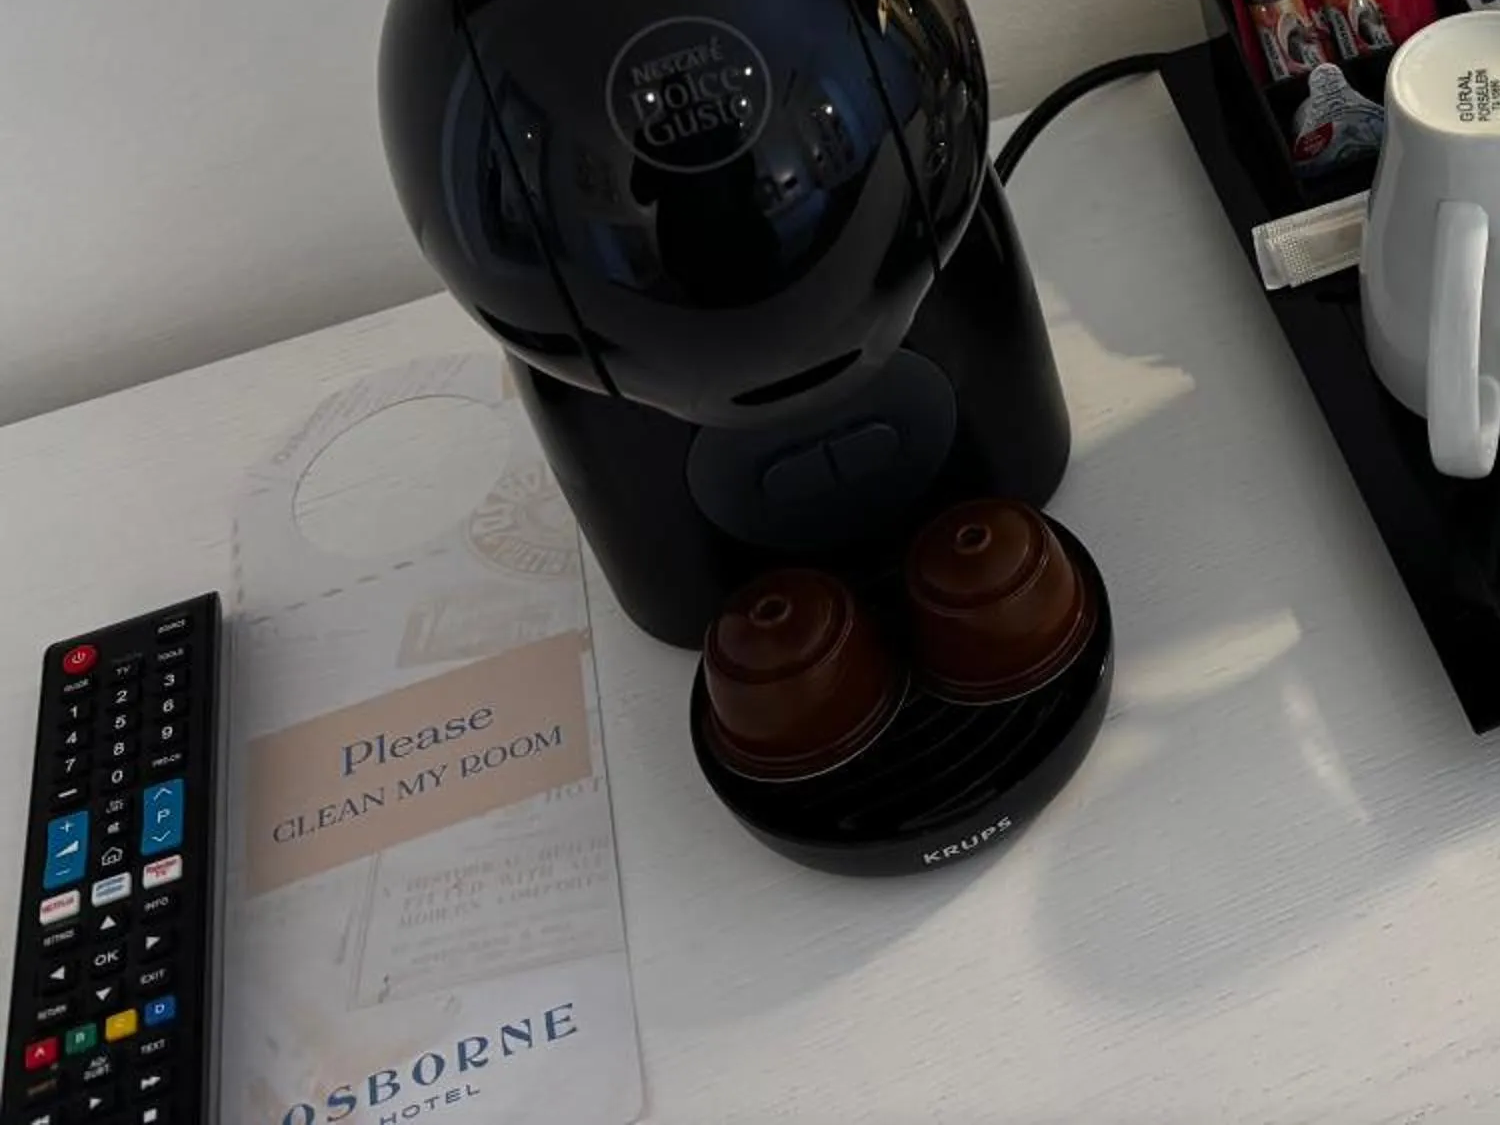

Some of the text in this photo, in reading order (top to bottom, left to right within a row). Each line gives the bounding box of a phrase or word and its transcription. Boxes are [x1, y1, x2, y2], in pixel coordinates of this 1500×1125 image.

[164, 672, 176, 687] 3
[115, 689, 129, 704] 2
[69, 704, 78, 719] 1
[162, 698, 175, 713] 6
[114, 714, 127, 730] 5
[65, 730, 78, 744] 4
[161, 725, 174, 740] 9
[113, 741, 126, 756] 8
[342, 705, 495, 777] Please
[64, 757, 77, 773] 7
[111, 769, 124, 784] 0
[272, 724, 563, 844] CLEAN MY ROOM
[157, 807, 170, 824] P
[923, 816, 1013, 865] KRUPS
[144, 895, 169, 911] INFO
[94, 950, 120, 966] OK
[140, 967, 167, 985] EXIT
[154, 1003, 165, 1014] D
[34, 1046, 45, 1058] A
[140, 1038, 166, 1054] TEXT
[282, 1002, 578, 1125] OSBORNE
[380, 1084, 481, 1125] HOTEL
